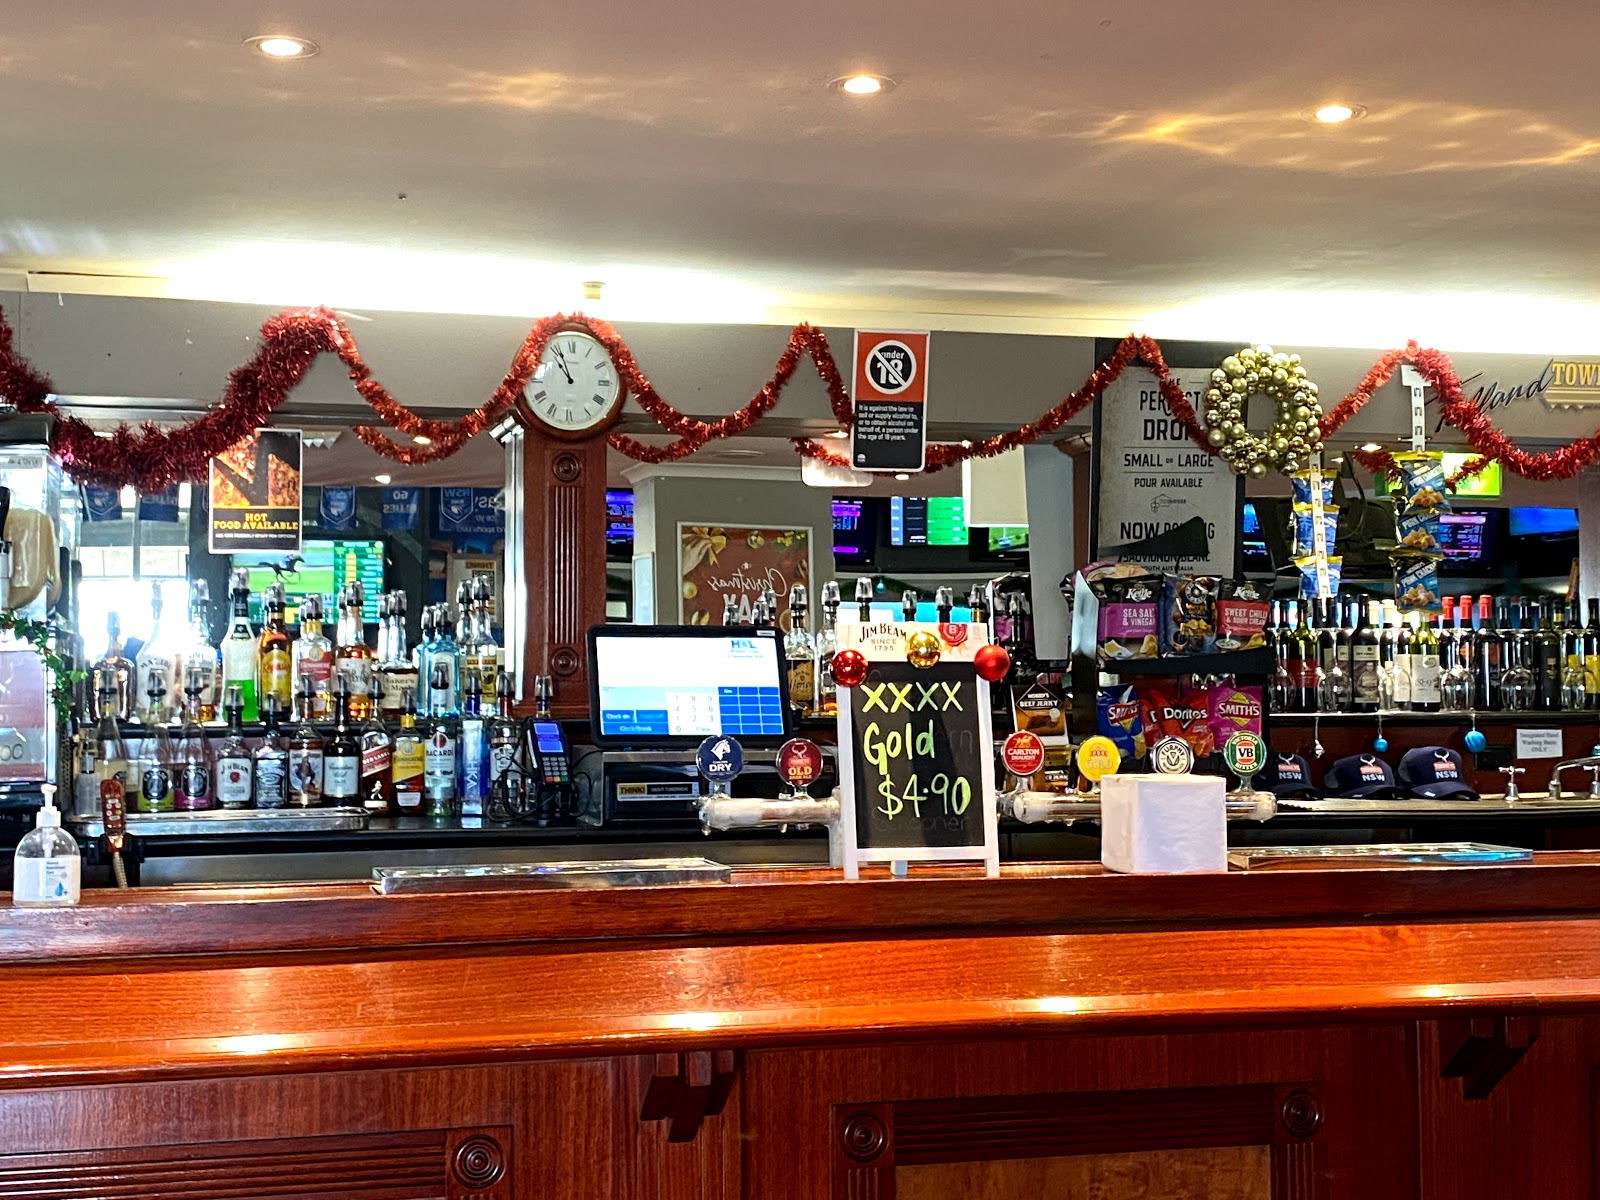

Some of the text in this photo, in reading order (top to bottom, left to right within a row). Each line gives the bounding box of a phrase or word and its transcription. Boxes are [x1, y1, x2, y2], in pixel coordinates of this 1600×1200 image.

[877, 359, 904, 385] 18
[1552, 362, 1600, 386] TOW
[1123, 453, 1163, 467] SMALL
[1177, 453, 1215, 468] LARGE
[1134, 477, 1203, 488] POUR AVAILABLE
[244, 512, 268, 522] HOT
[213, 520, 299, 530] FOOD AVAILABLE
[1120, 522, 1160, 540] NOW
[1122, 607, 1138, 618] SEA
[1224, 607, 1247, 618] SWEET
[1122, 617, 1129, 626] &
[1232, 616, 1249, 625] SOUR
[859, 622, 908, 643] JIM BEAM
[859, 681, 964, 713] XXXX
[1035, 700, 1059, 708] JERKY
[1218, 703, 1260, 716] SMITH'S
[1163, 707, 1208, 720] Doritos
[863, 719, 935, 776] Gold
[1007, 748, 1040, 756] CARLTON
[1161, 744, 1186, 756] FURPHY
[1238, 747, 1254, 757] VB
[709, 763, 732, 772] DRY
[788, 766, 813, 776] OLD
[1279, 771, 1302, 780] NSW
[1362, 773, 1385, 782] NSW
[1435, 770, 1458, 779] NSW
